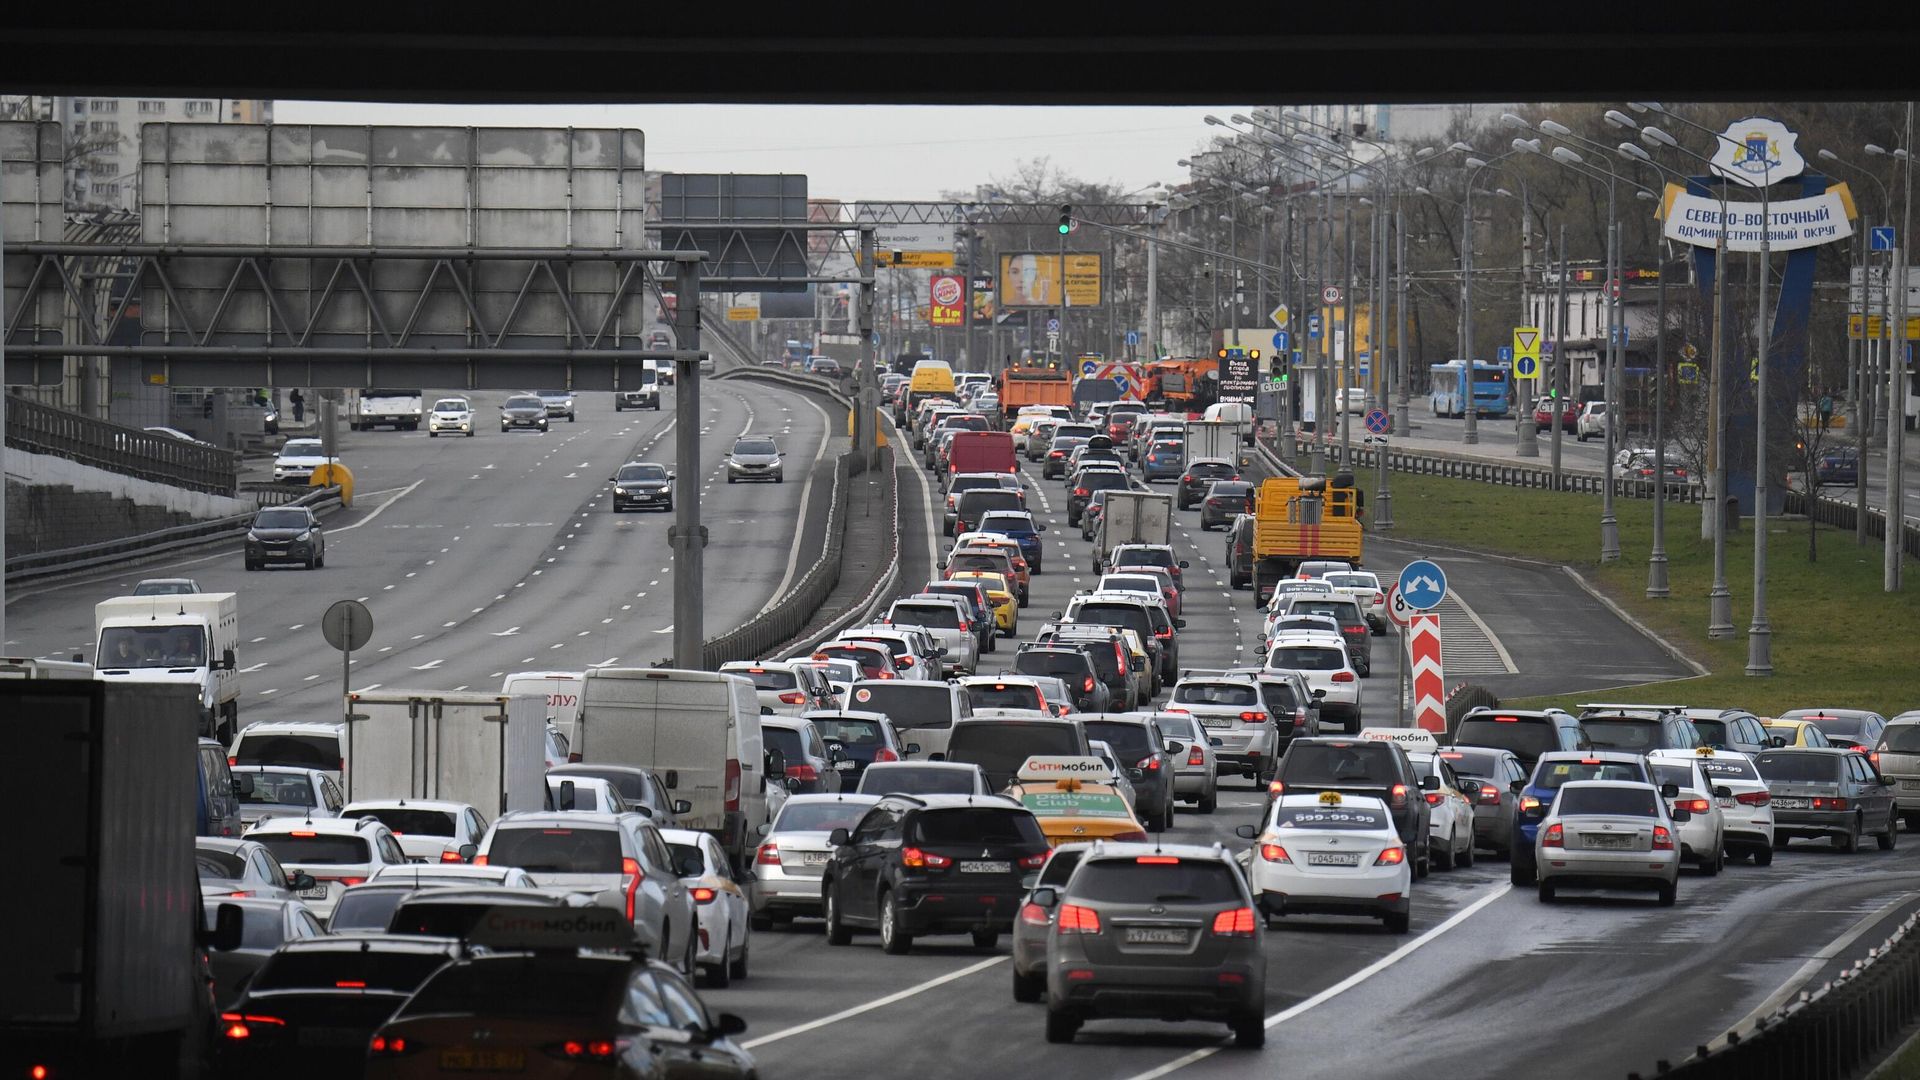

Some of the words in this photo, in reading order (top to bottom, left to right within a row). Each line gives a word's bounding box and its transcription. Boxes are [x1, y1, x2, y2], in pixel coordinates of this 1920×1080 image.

[1803, 224, 1837, 239] ОКРУГ
[1326, 290, 1336, 298] 80
[1264, 382, 1286, 391] СТОП
[1541, 403, 1568, 411] СТП
[1363, 732, 1429, 742] Ситимобил
[1028, 761, 1103, 772] Ситимобил
[1036, 793, 1111, 803] Delivery
[1036, 799, 1079, 807] Club
[1295, 813, 1375, 823] 599-99-99
[488, 912, 617, 933] Ситимобил
